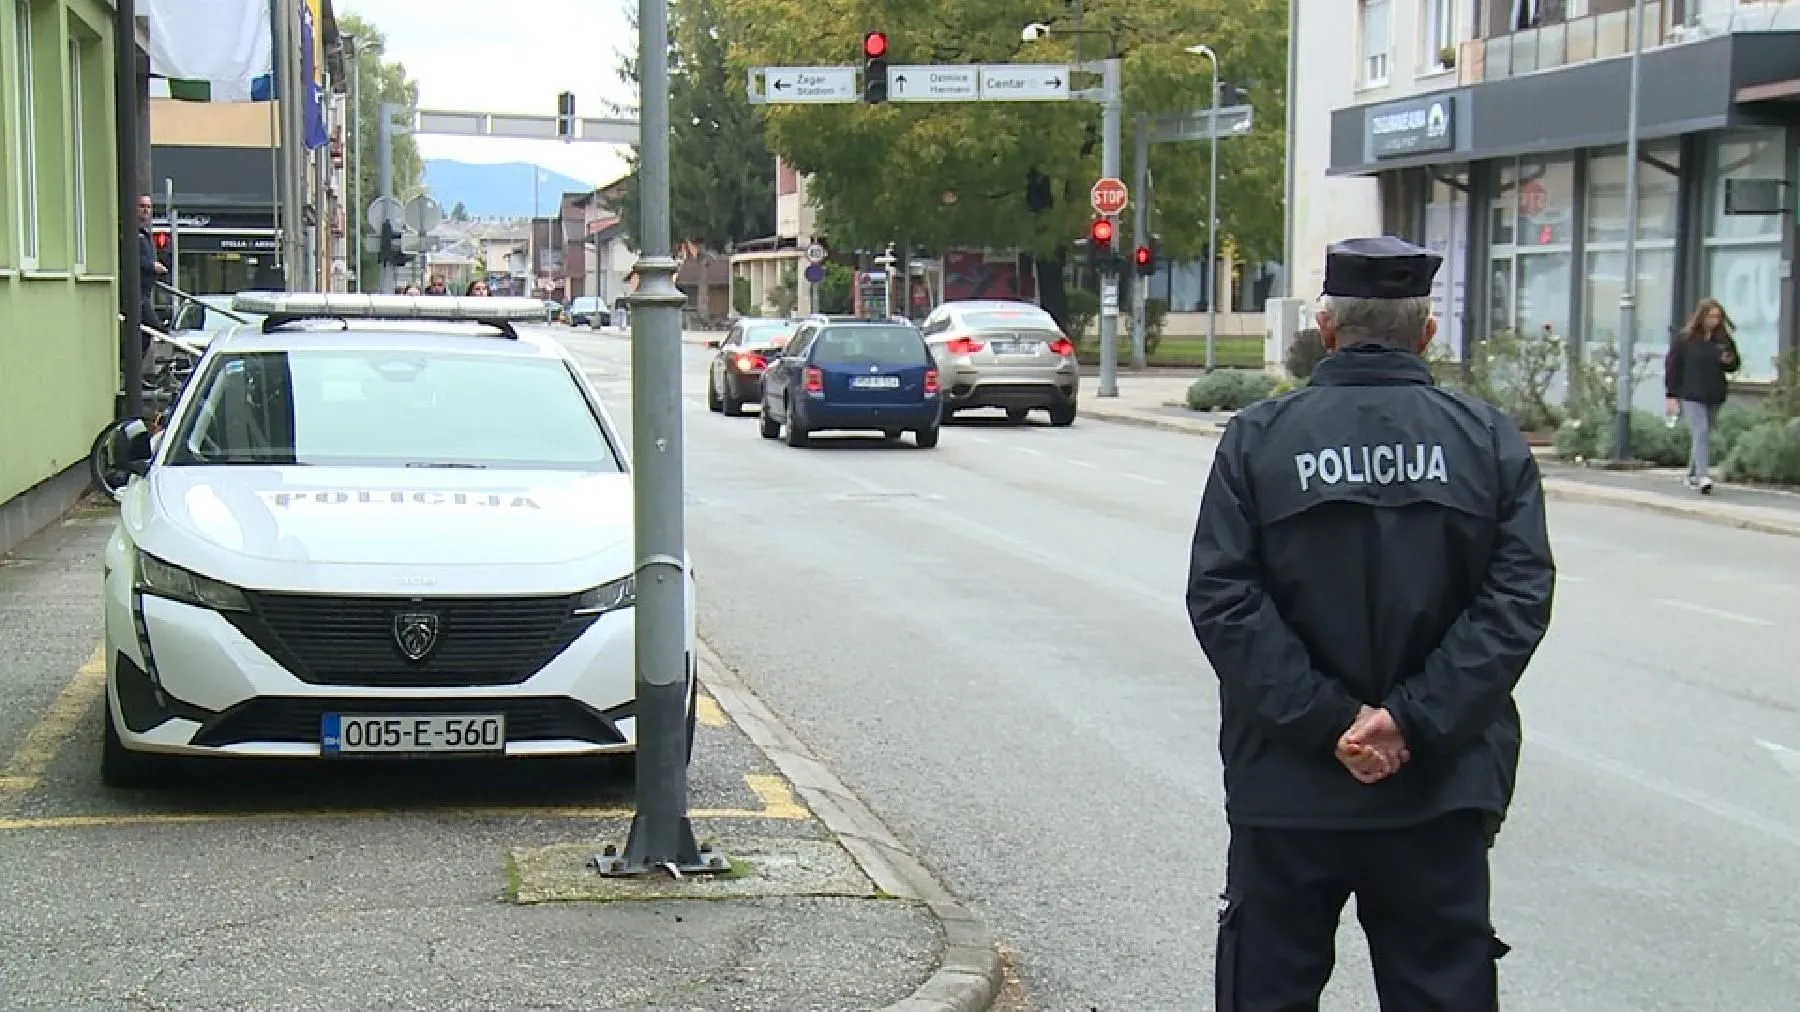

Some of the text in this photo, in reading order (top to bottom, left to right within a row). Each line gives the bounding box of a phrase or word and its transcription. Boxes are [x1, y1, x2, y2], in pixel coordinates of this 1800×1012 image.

[986, 78, 1026, 90] Centar
[1095, 190, 1124, 205] STOP
[1294, 443, 1448, 492] POLICIJA
[274, 491, 541, 510] POLICIJA
[345, 720, 498, 747] 005-E-560
